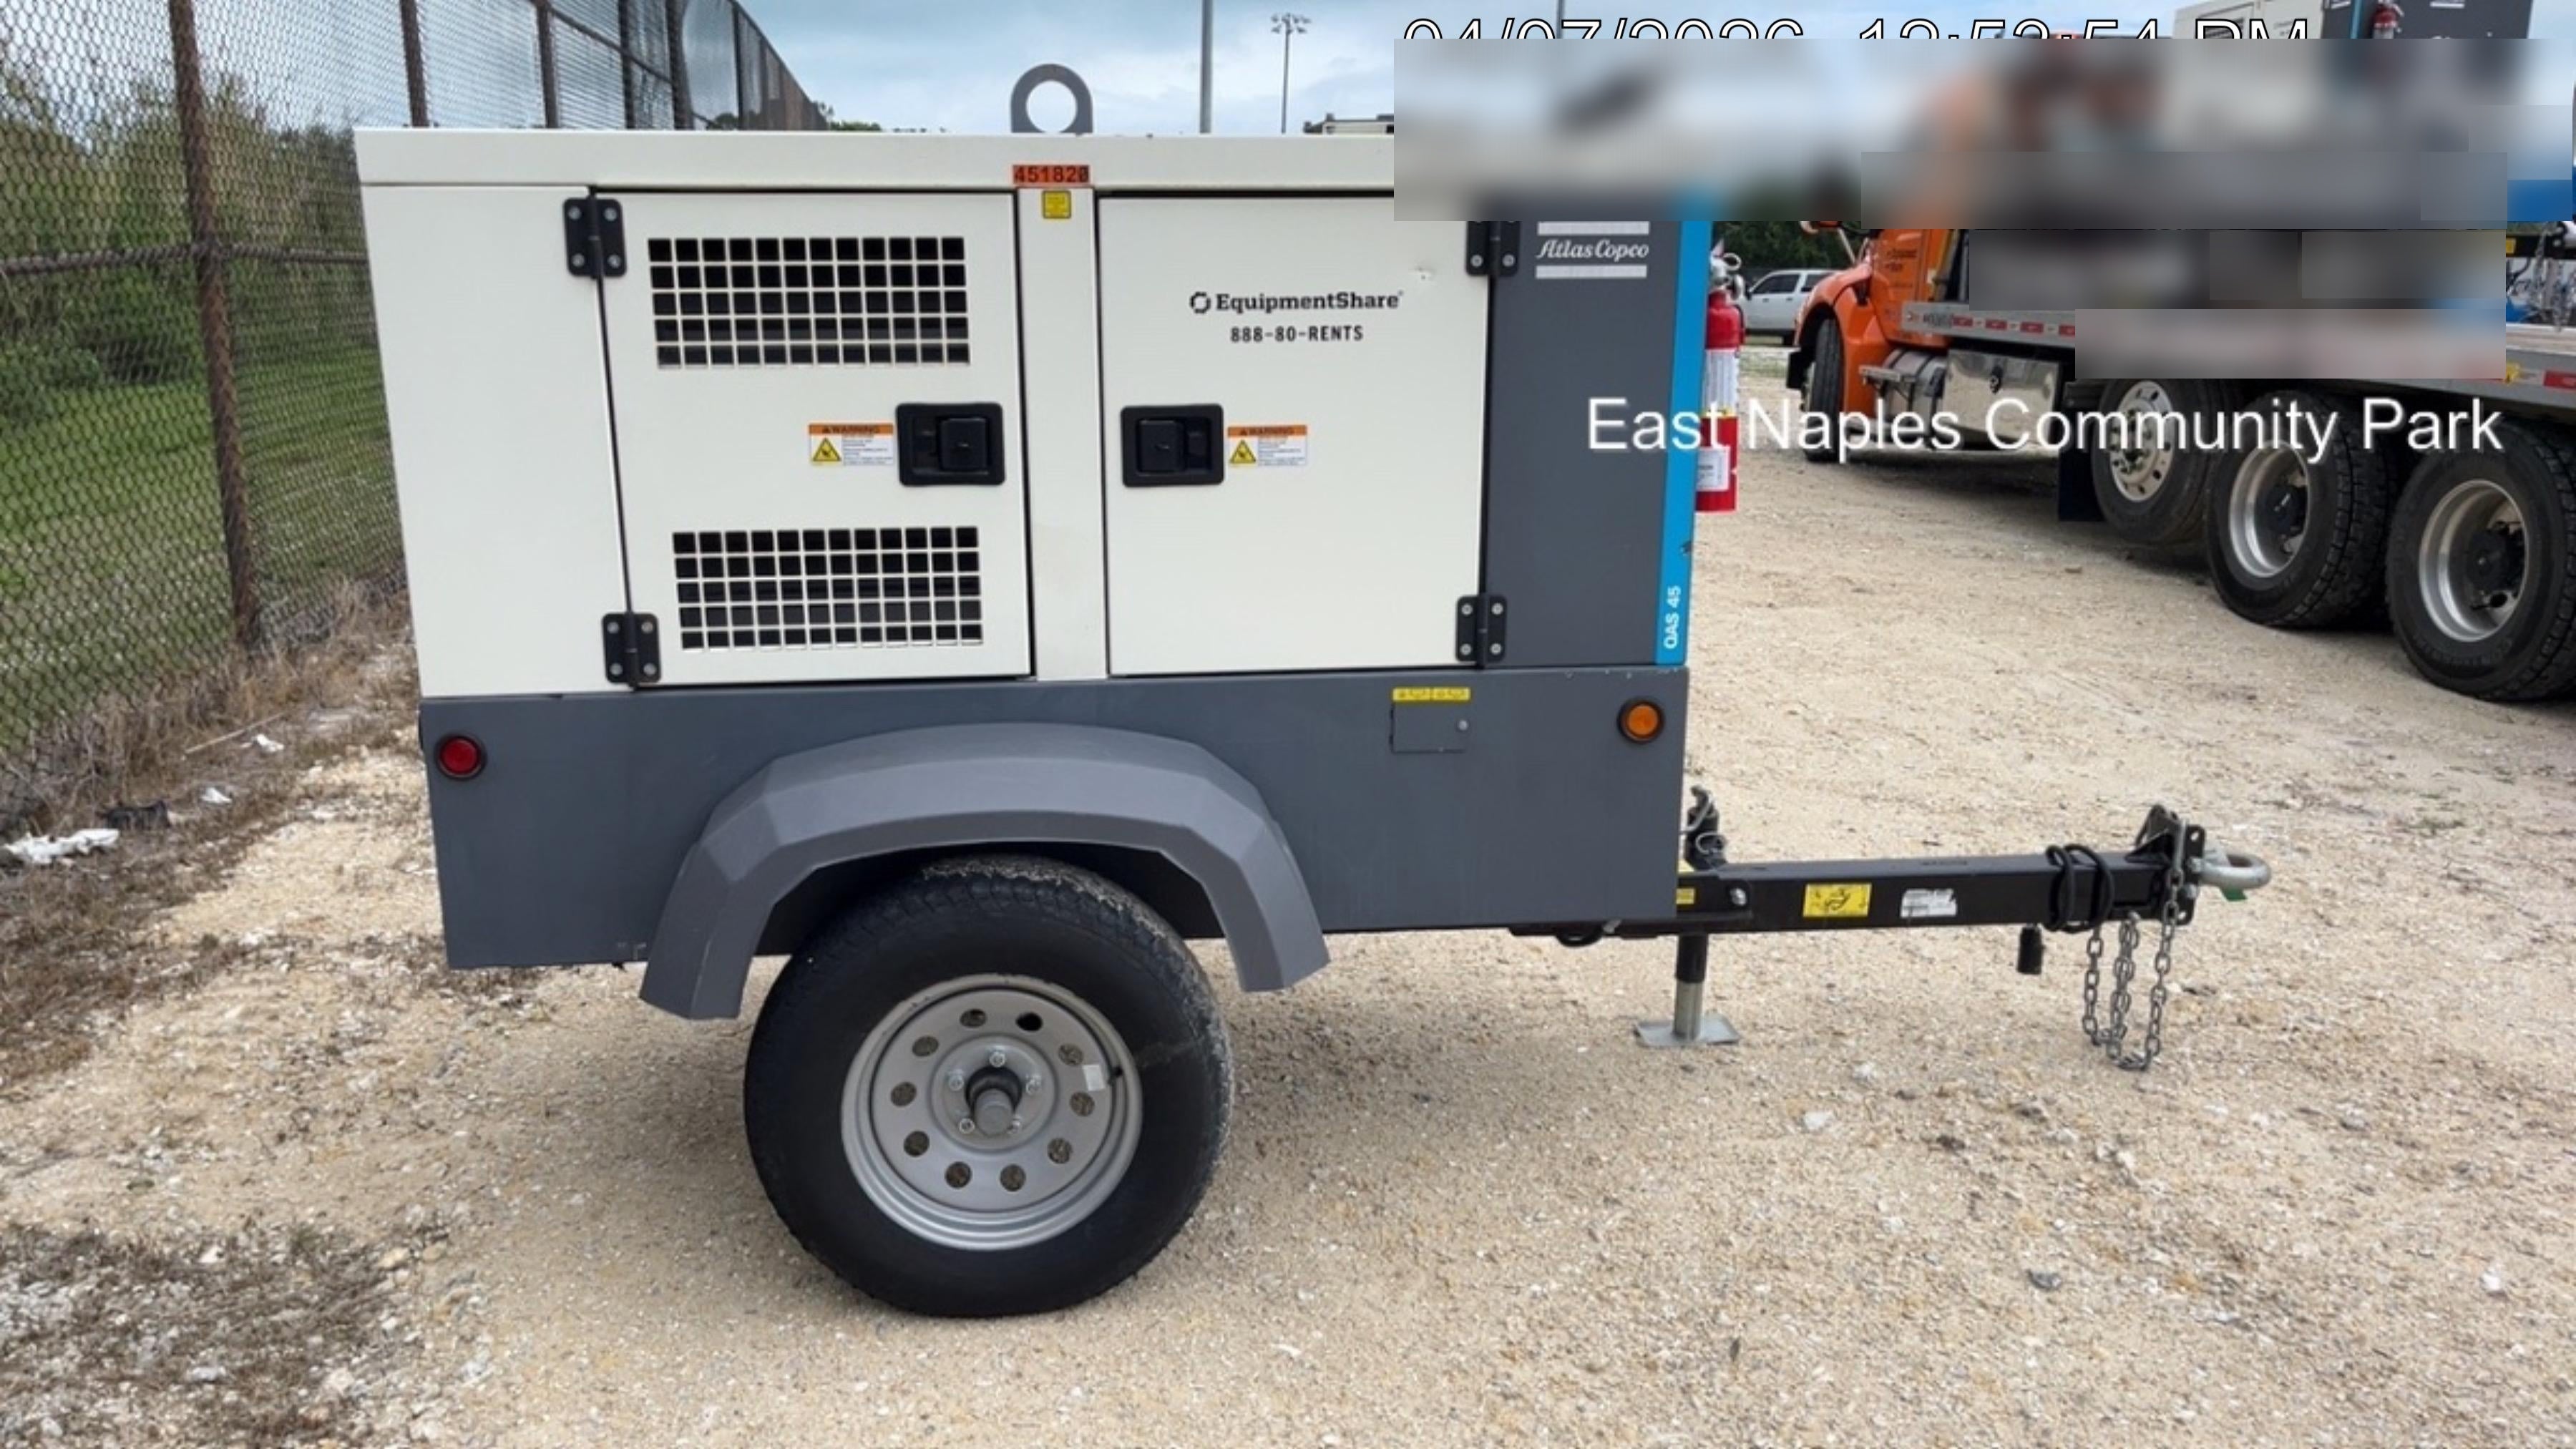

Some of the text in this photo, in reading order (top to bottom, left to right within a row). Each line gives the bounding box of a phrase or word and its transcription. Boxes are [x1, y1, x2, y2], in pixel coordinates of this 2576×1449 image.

[1014, 165, 1089, 183] 451820
[1536, 239, 1650, 263] Atlas Copco
[1216, 291, 1400, 314] EquipmentShare
[1230, 324, 1364, 343] 888-80-RENTS
[1663, 585, 1682, 649] QAS 45
